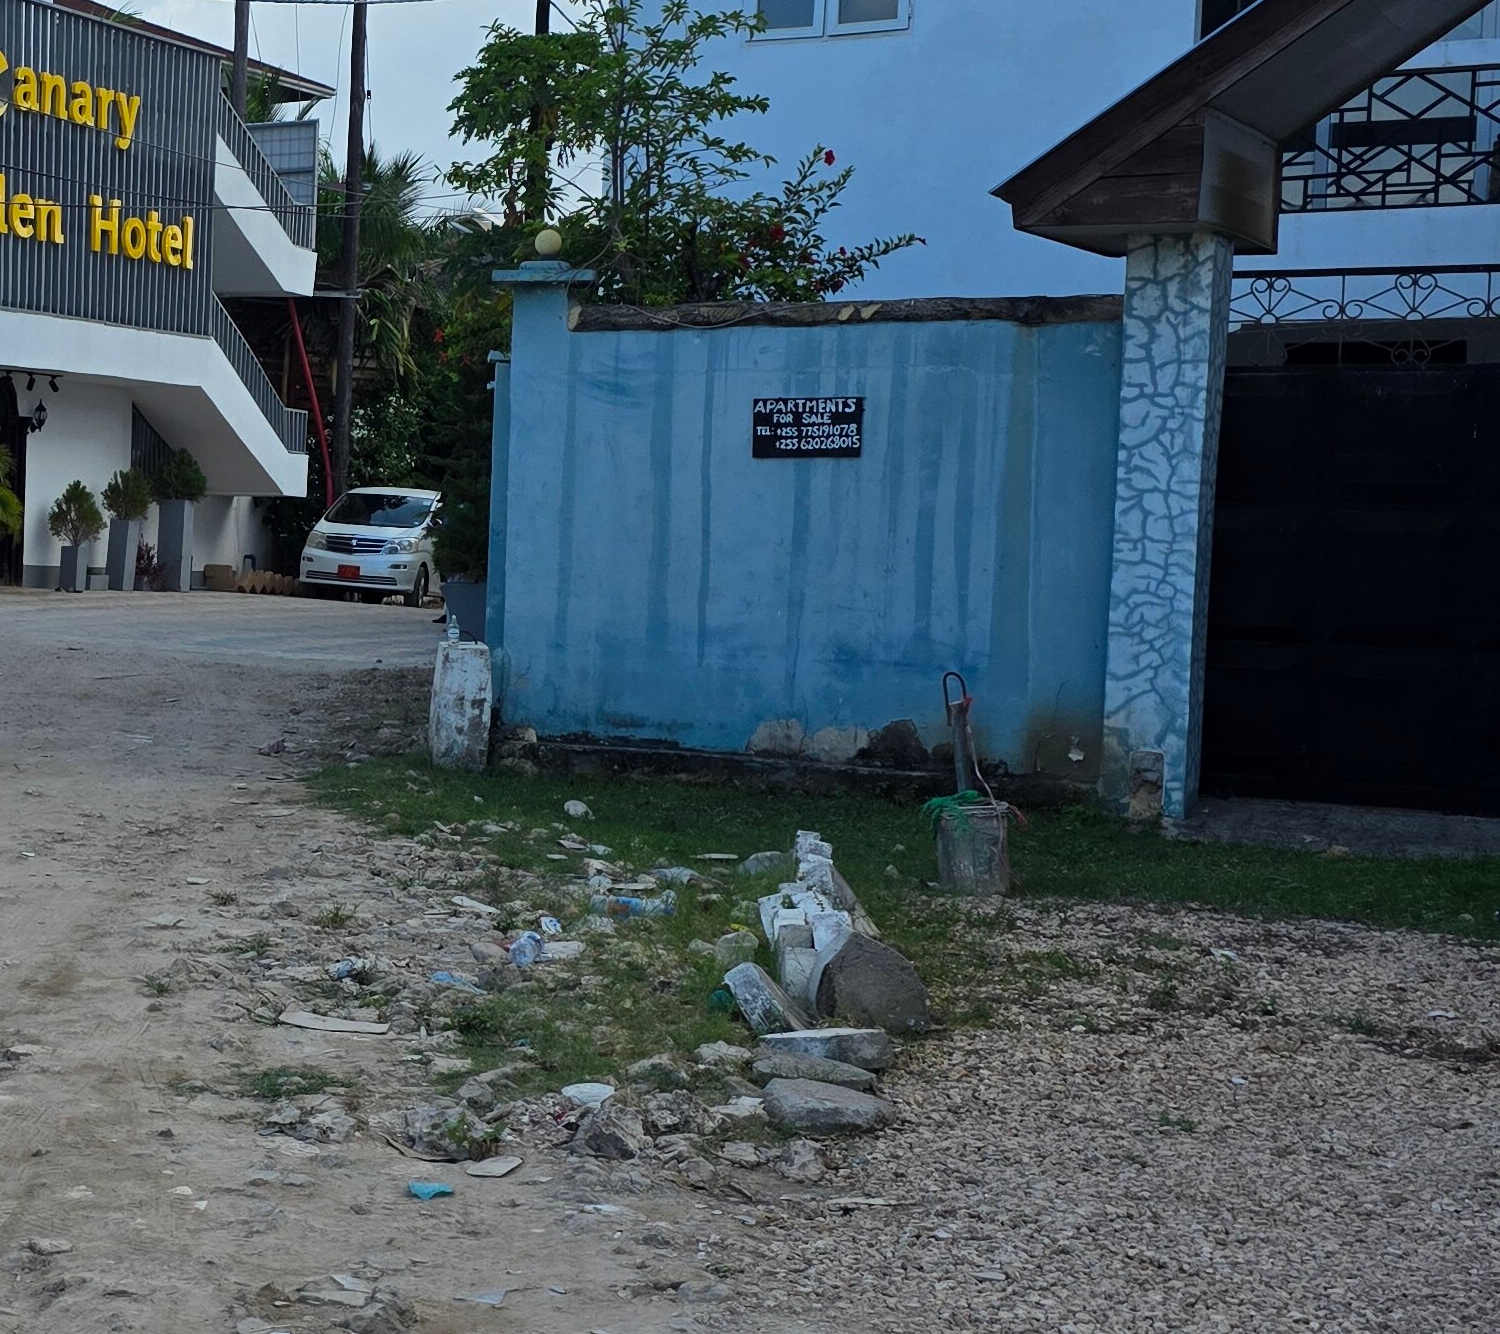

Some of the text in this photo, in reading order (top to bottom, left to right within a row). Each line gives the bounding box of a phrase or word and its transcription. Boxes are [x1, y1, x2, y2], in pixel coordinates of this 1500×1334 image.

[90, 194, 194, 270] Hotel
[754, 398, 857, 413] APARTMENTS
[773, 413, 832, 424] FOR SALE
[756, 424, 858, 437] TEL: +255 775191078
[775, 436, 861, 450] +255 620268015
